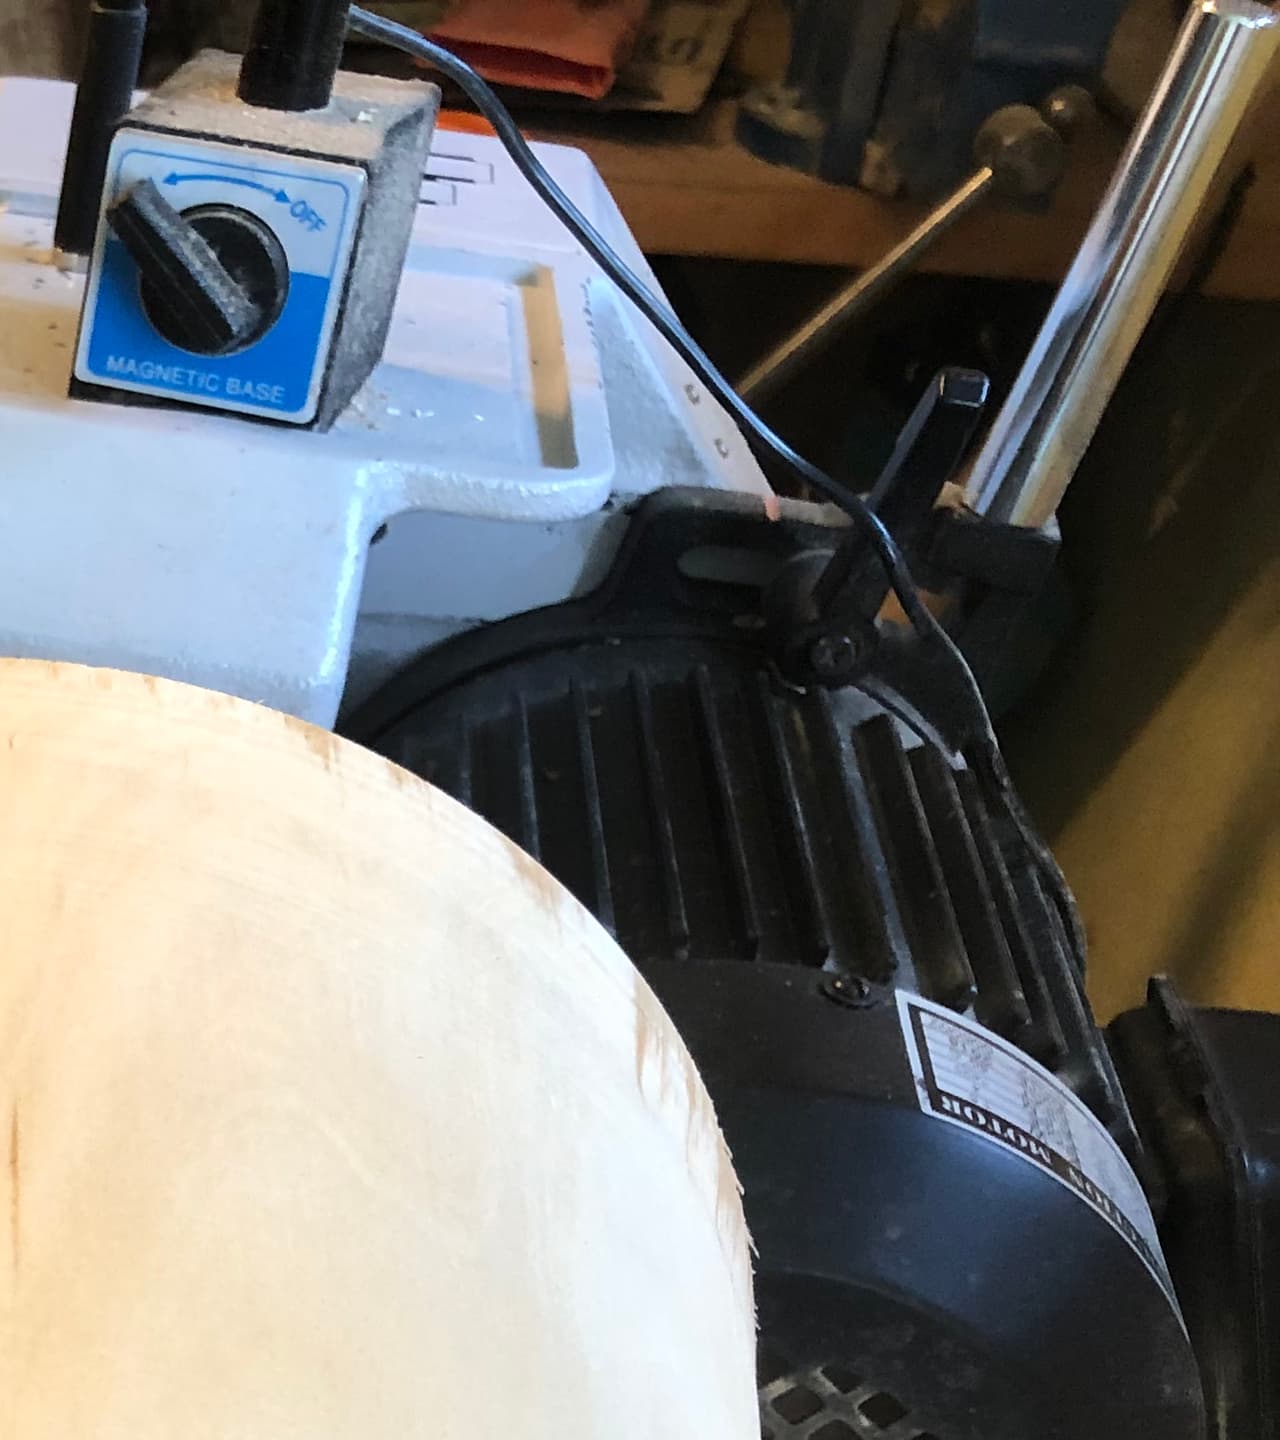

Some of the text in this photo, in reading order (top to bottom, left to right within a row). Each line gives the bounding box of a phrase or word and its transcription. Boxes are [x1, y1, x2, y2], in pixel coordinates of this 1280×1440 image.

[290, 199, 327, 232] OFF
[106, 354, 286, 405] MAGNETIC BASE
[940, 1094, 1053, 1166] MOTOR
